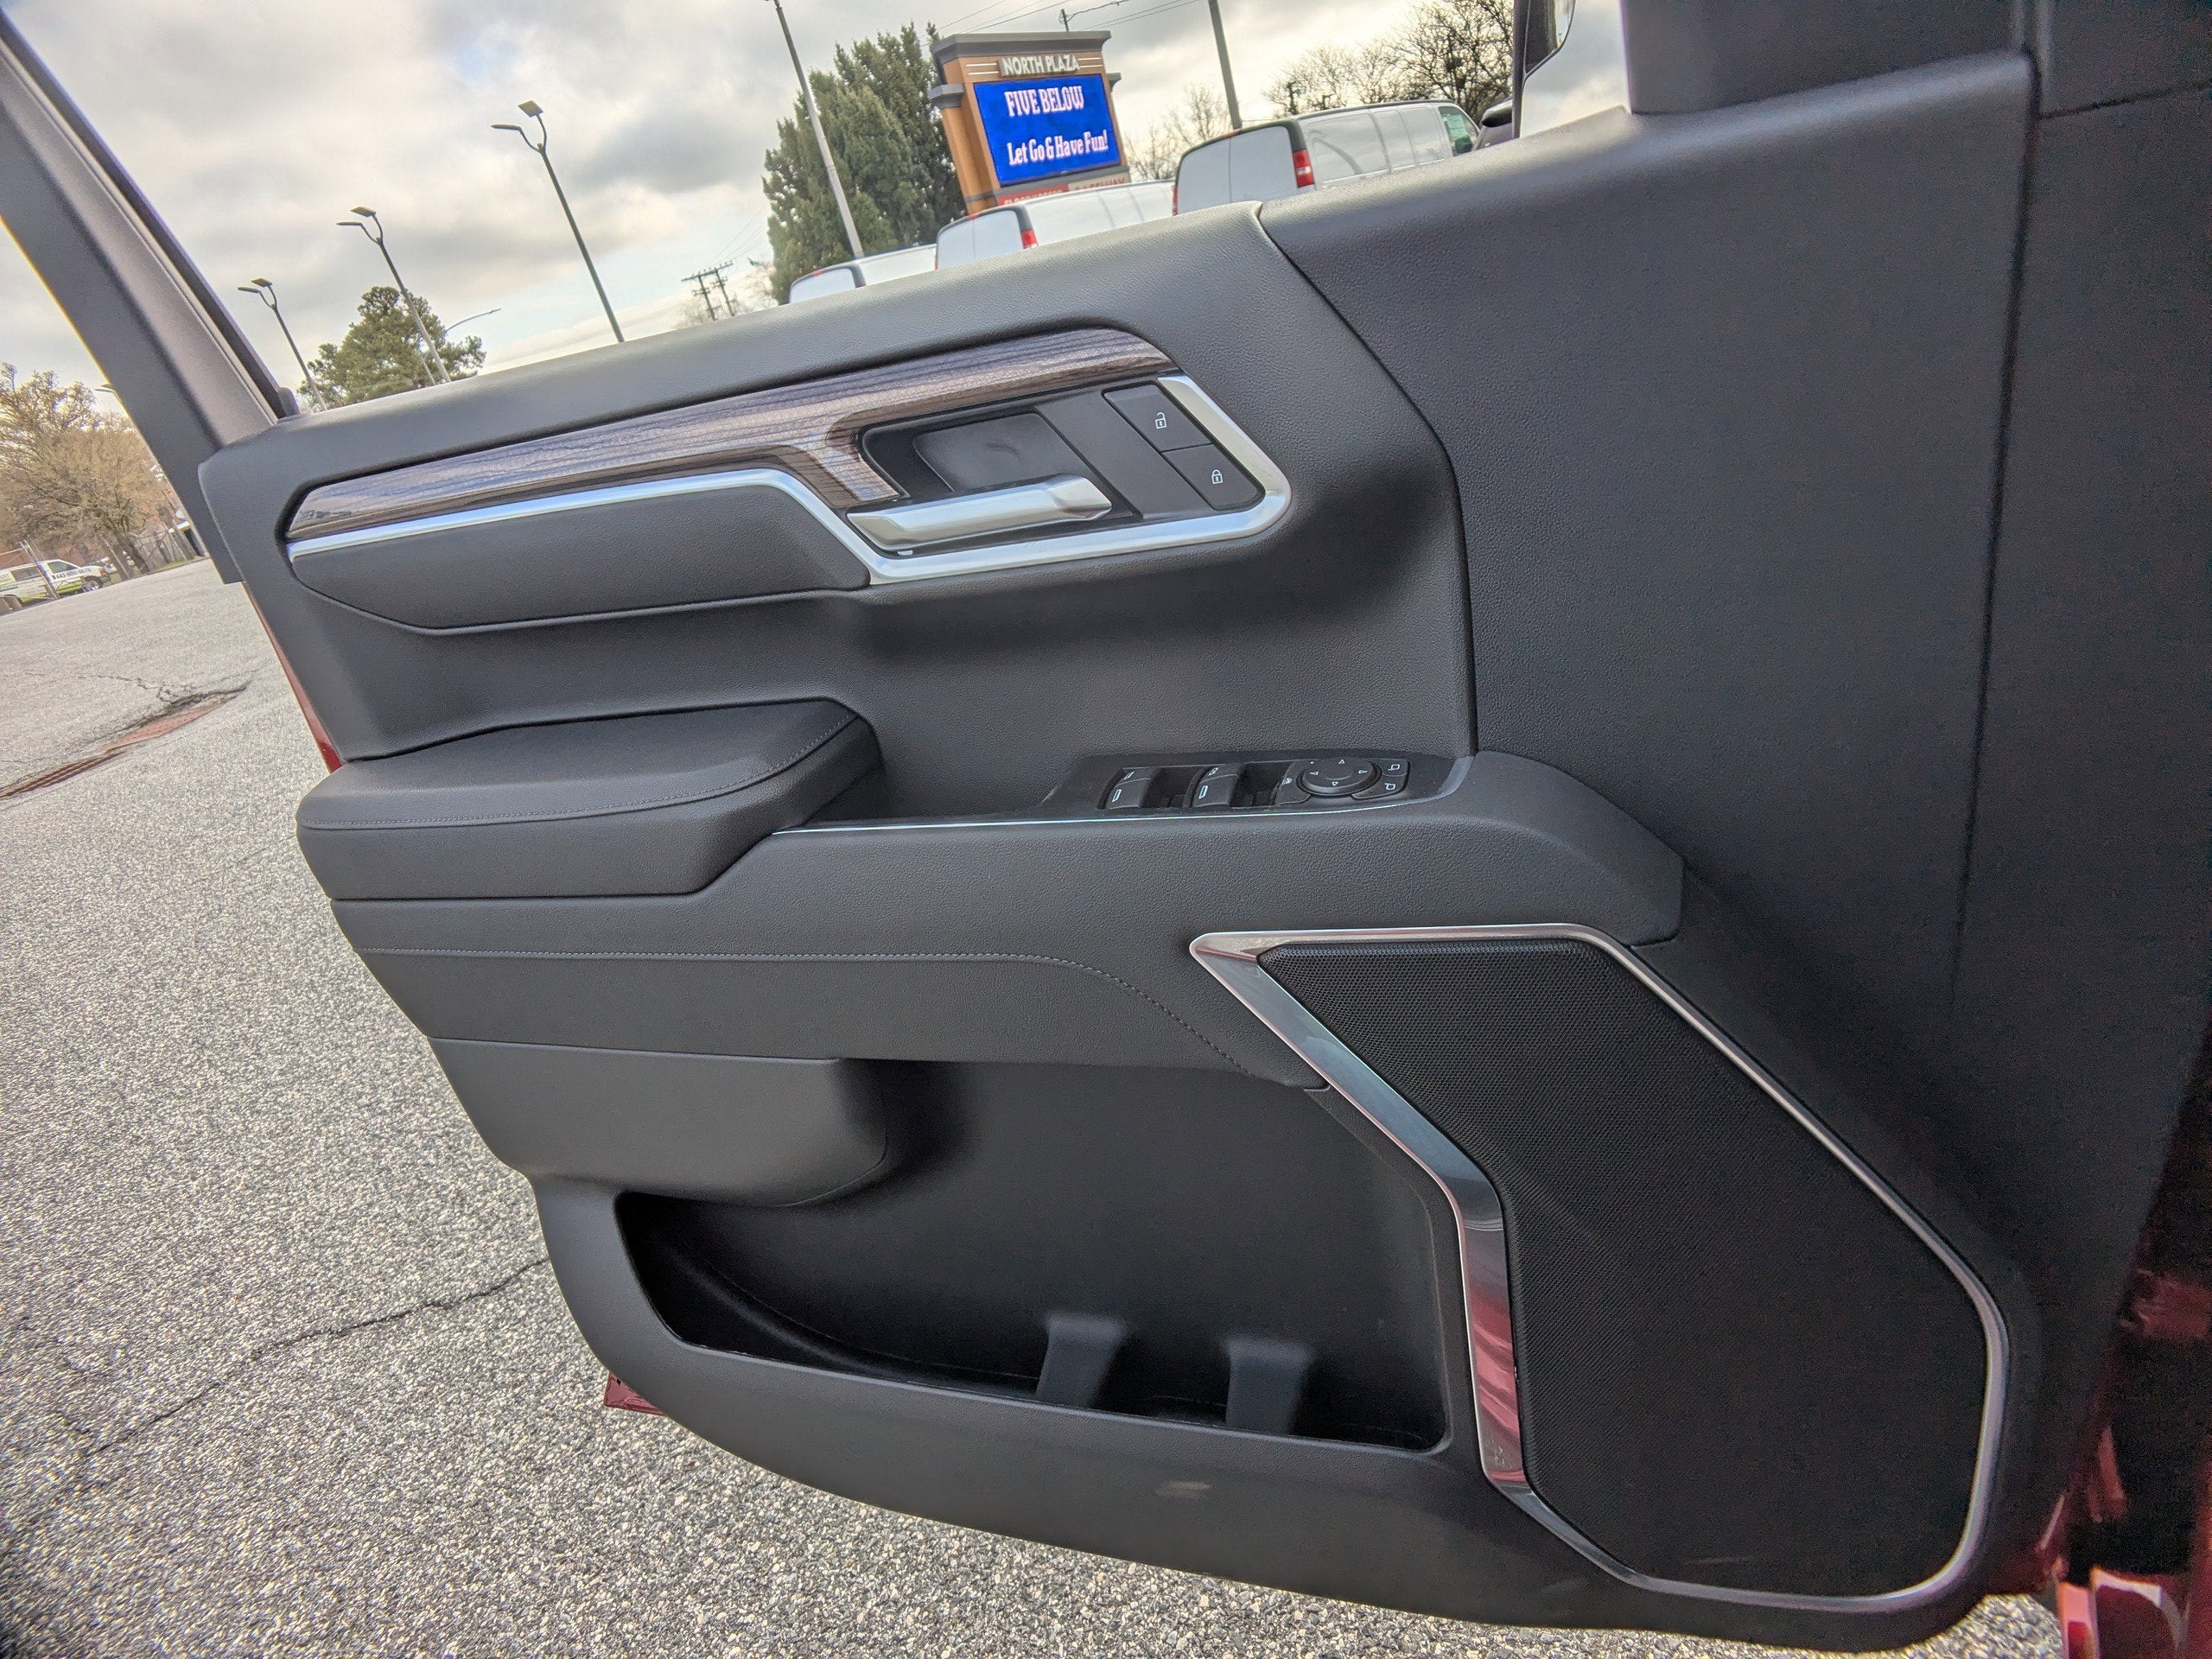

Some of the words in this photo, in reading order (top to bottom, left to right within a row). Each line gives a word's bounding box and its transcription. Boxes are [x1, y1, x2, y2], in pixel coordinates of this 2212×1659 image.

[1002, 56, 1045, 76] NORTH
[1045, 54, 1080, 73] PLAZA
[1004, 89, 1040, 118] FIVE
[1038, 86, 1084, 113] BELOW
[1007, 142, 1028, 166] Let
[1028, 138, 1046, 162] Go
[1046, 137, 1054, 160] &
[1053, 135, 1084, 158] Have
[1083, 129, 1109, 154] Fun!
